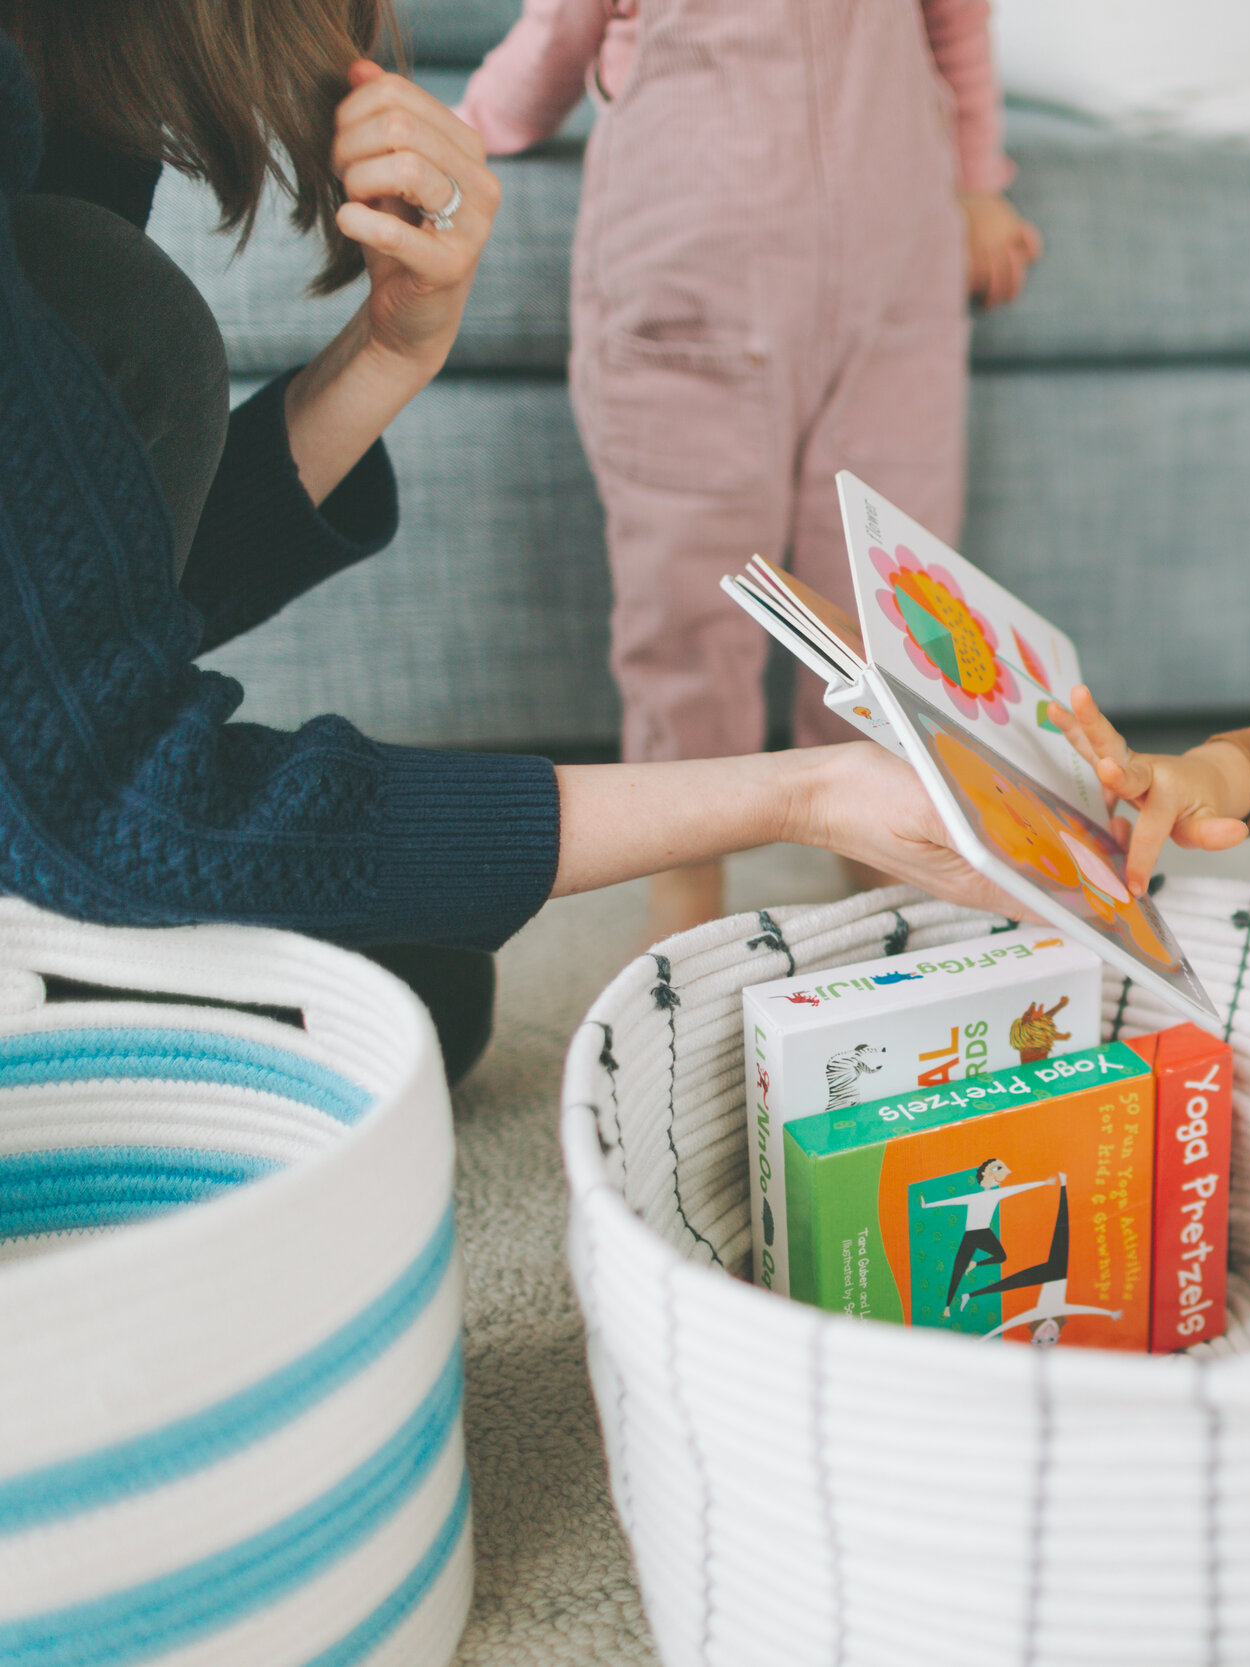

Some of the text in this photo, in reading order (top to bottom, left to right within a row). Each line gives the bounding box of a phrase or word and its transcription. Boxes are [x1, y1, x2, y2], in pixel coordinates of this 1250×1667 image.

[878, 1054, 1124, 1122] Yoga Pretzels
[1098, 1103, 1115, 1134] for
[1109, 1093, 1142, 1300] 50 Fun Yoga Activities
[1176, 1064, 1220, 1336] Yoga Pretzels
[858, 1227, 869, 1256] Tara
[1093, 1211, 1112, 1301] Grownups
[842, 1239, 854, 1288] Illustrated
[858, 1258, 870, 1289] Guber
[842, 1288, 854, 1300] by
[860, 1291, 871, 1309] and
